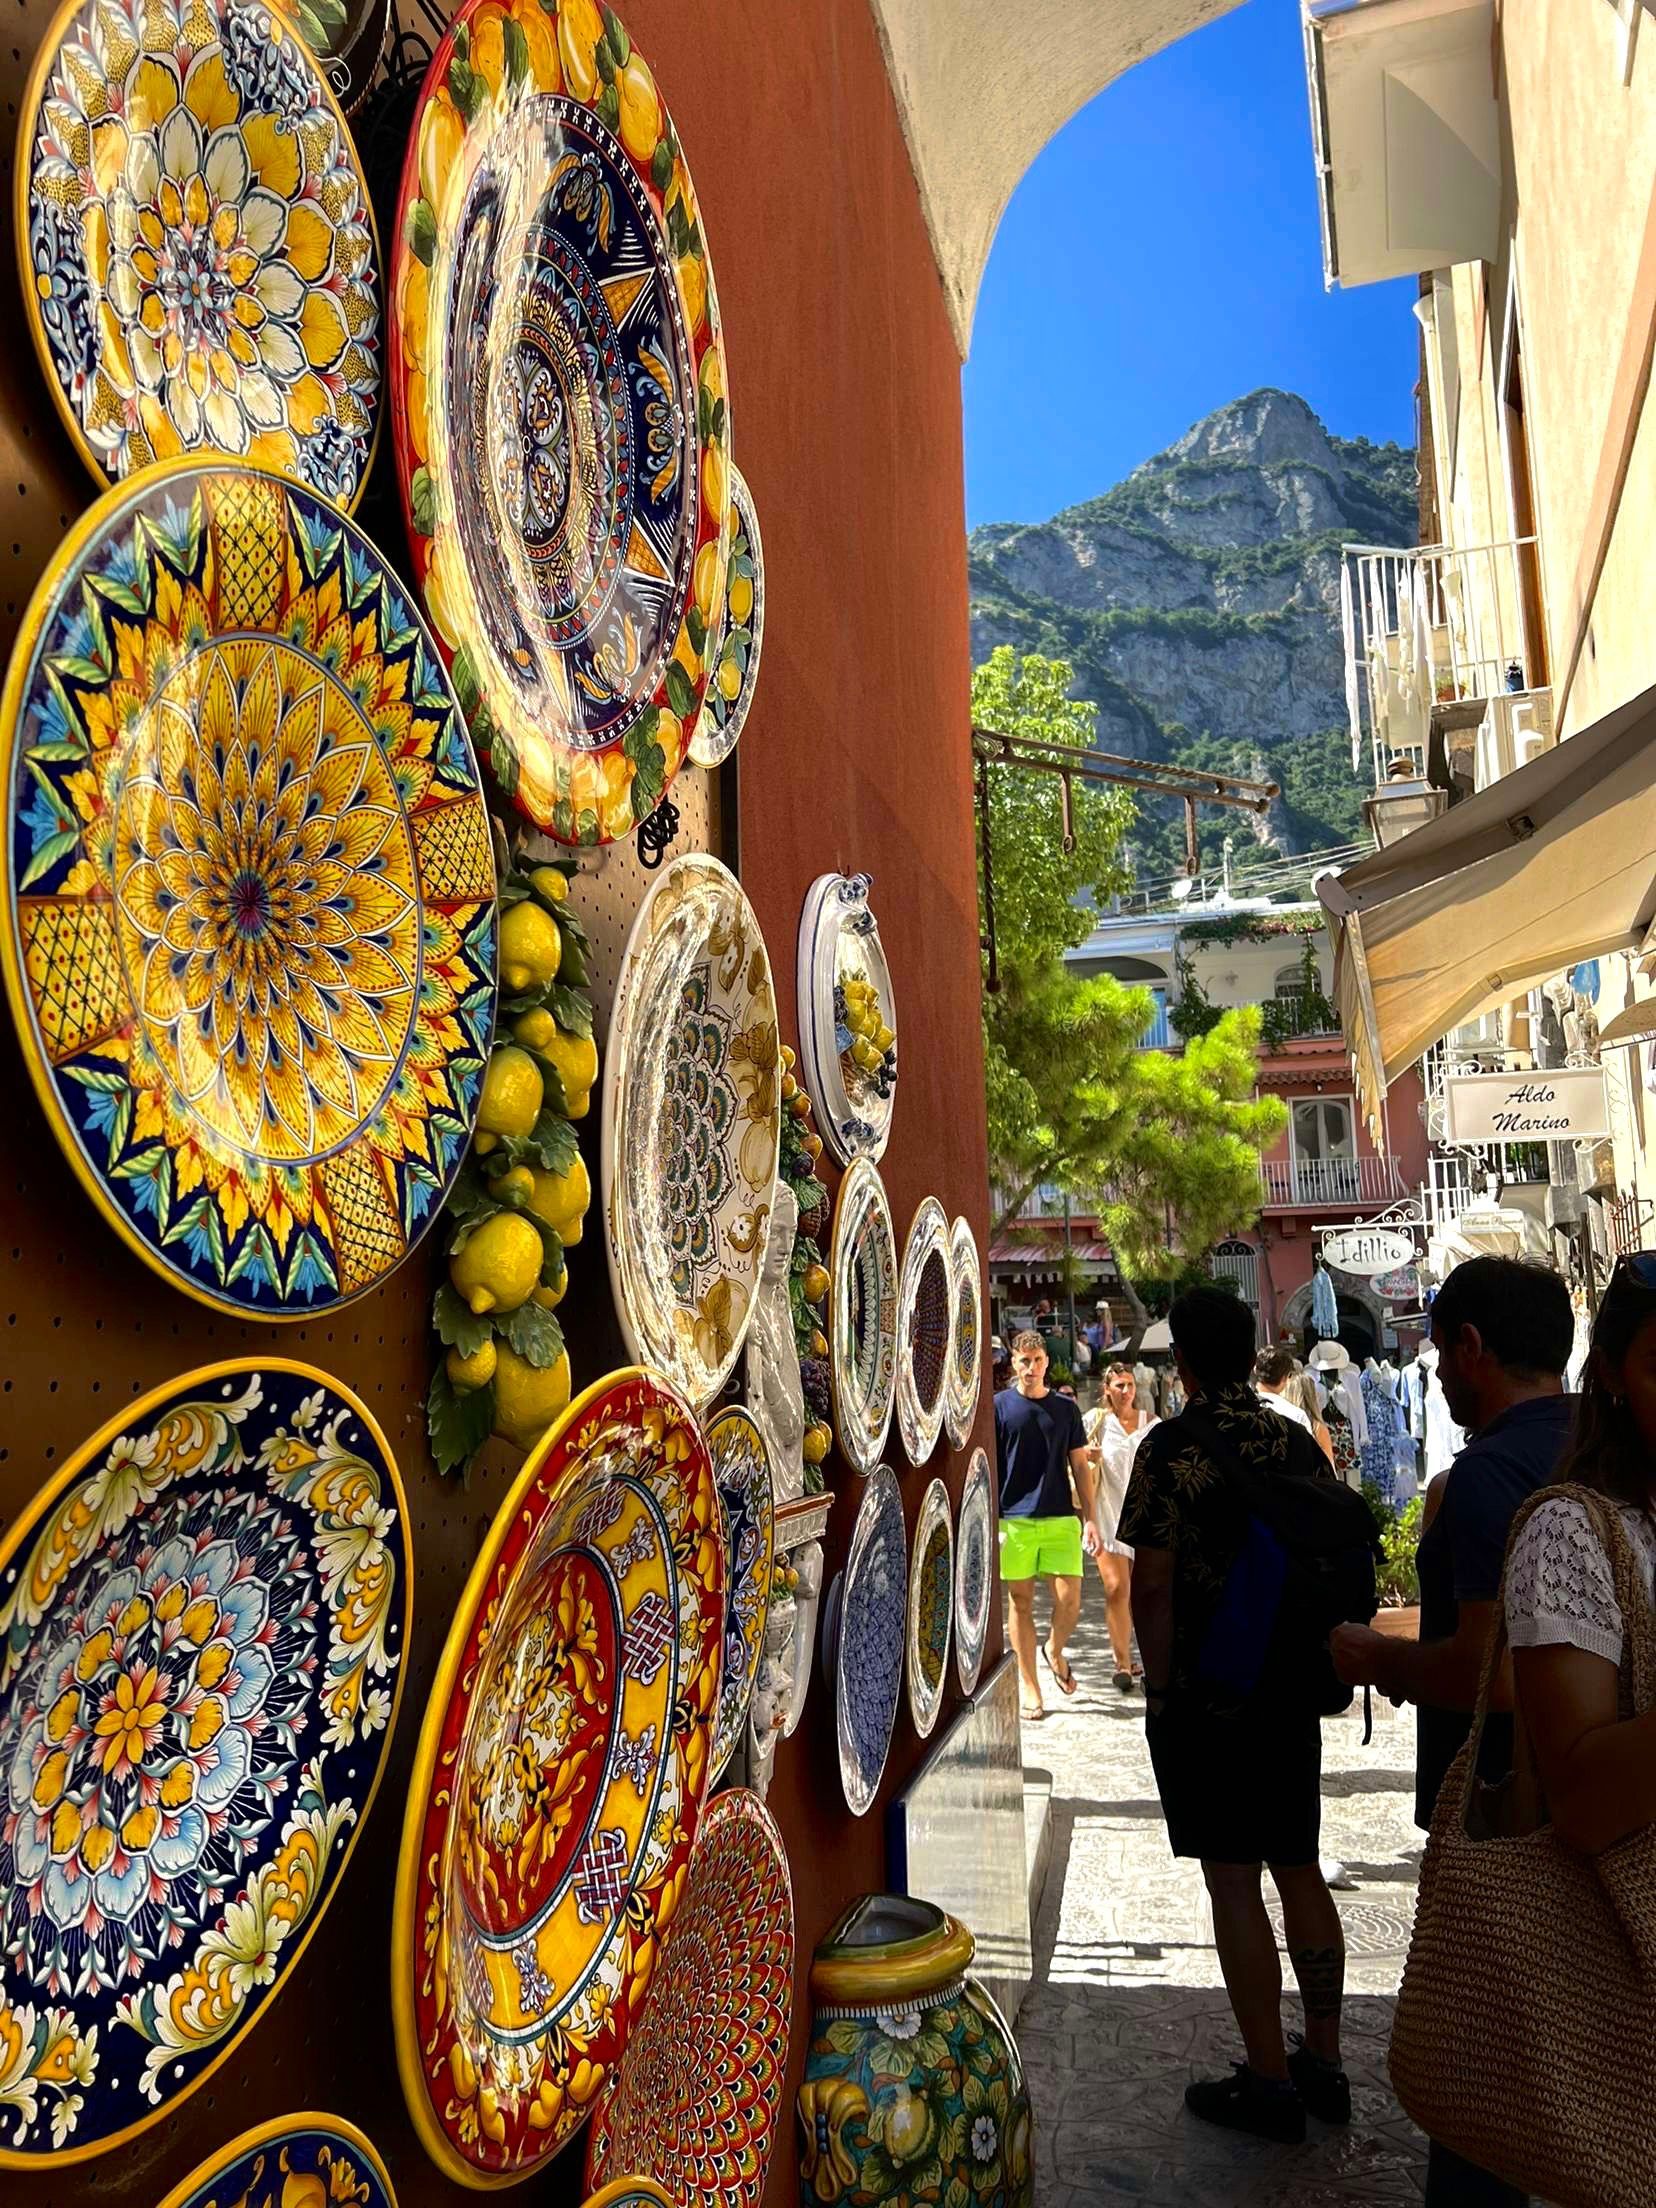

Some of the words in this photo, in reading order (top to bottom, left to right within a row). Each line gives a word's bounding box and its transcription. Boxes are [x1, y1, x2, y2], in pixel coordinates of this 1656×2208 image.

[1504, 1084, 1555, 1105] Aldo
[1492, 1112, 1570, 1132] Marino
[1336, 1237, 1401, 1264] Idillio
